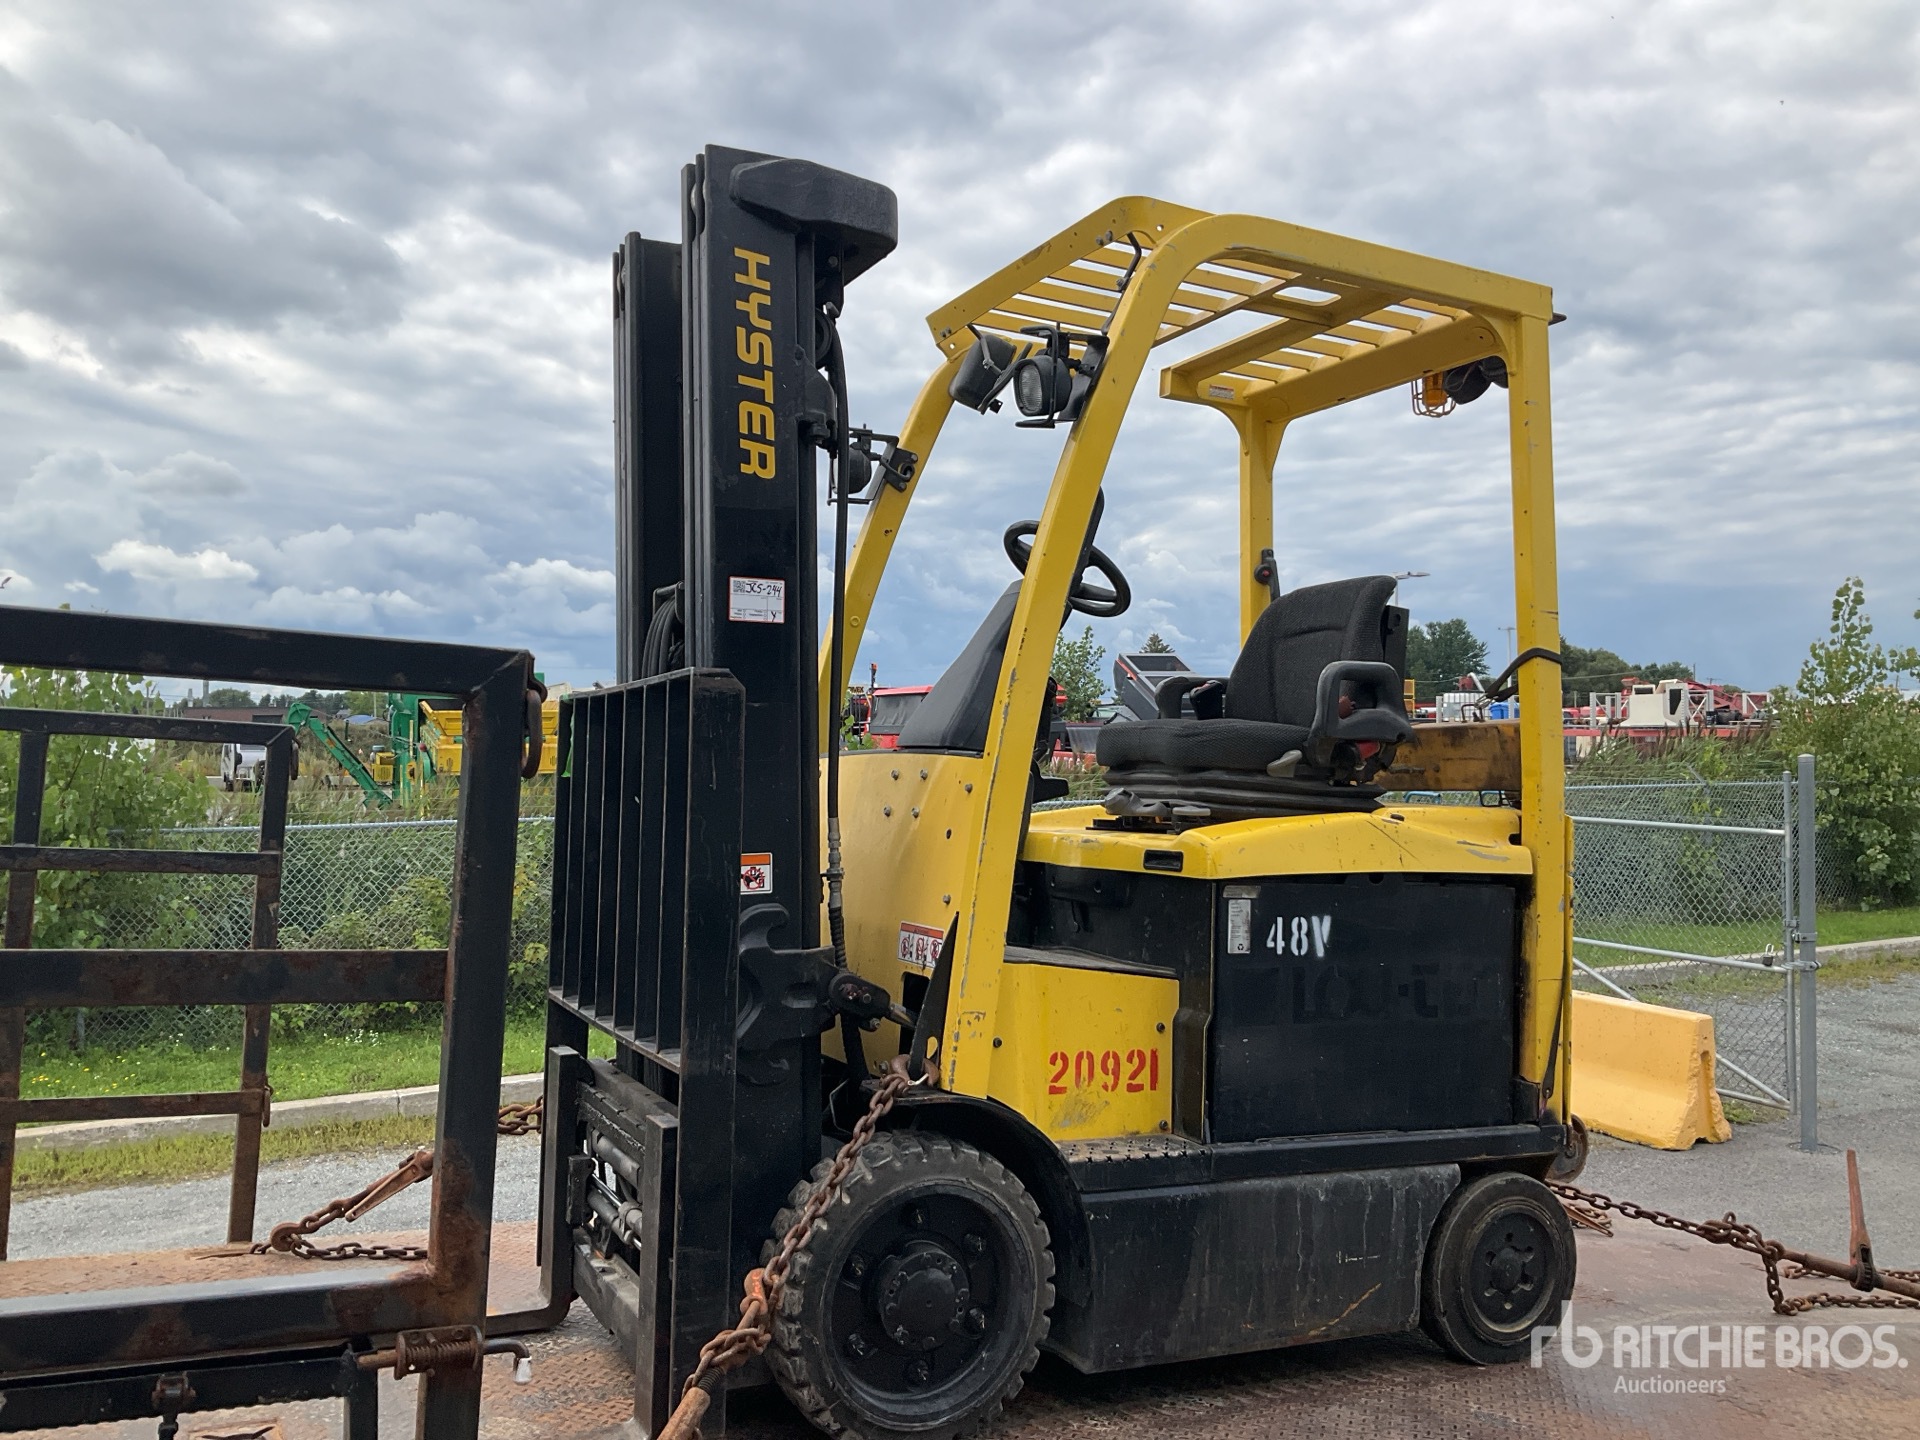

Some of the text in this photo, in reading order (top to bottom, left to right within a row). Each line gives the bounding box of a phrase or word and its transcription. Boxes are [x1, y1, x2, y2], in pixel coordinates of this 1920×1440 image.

[734, 247, 776, 480] HYSTER
[1266, 915, 1332, 958] 48V
[1048, 1048, 1159, 1095] 20921
